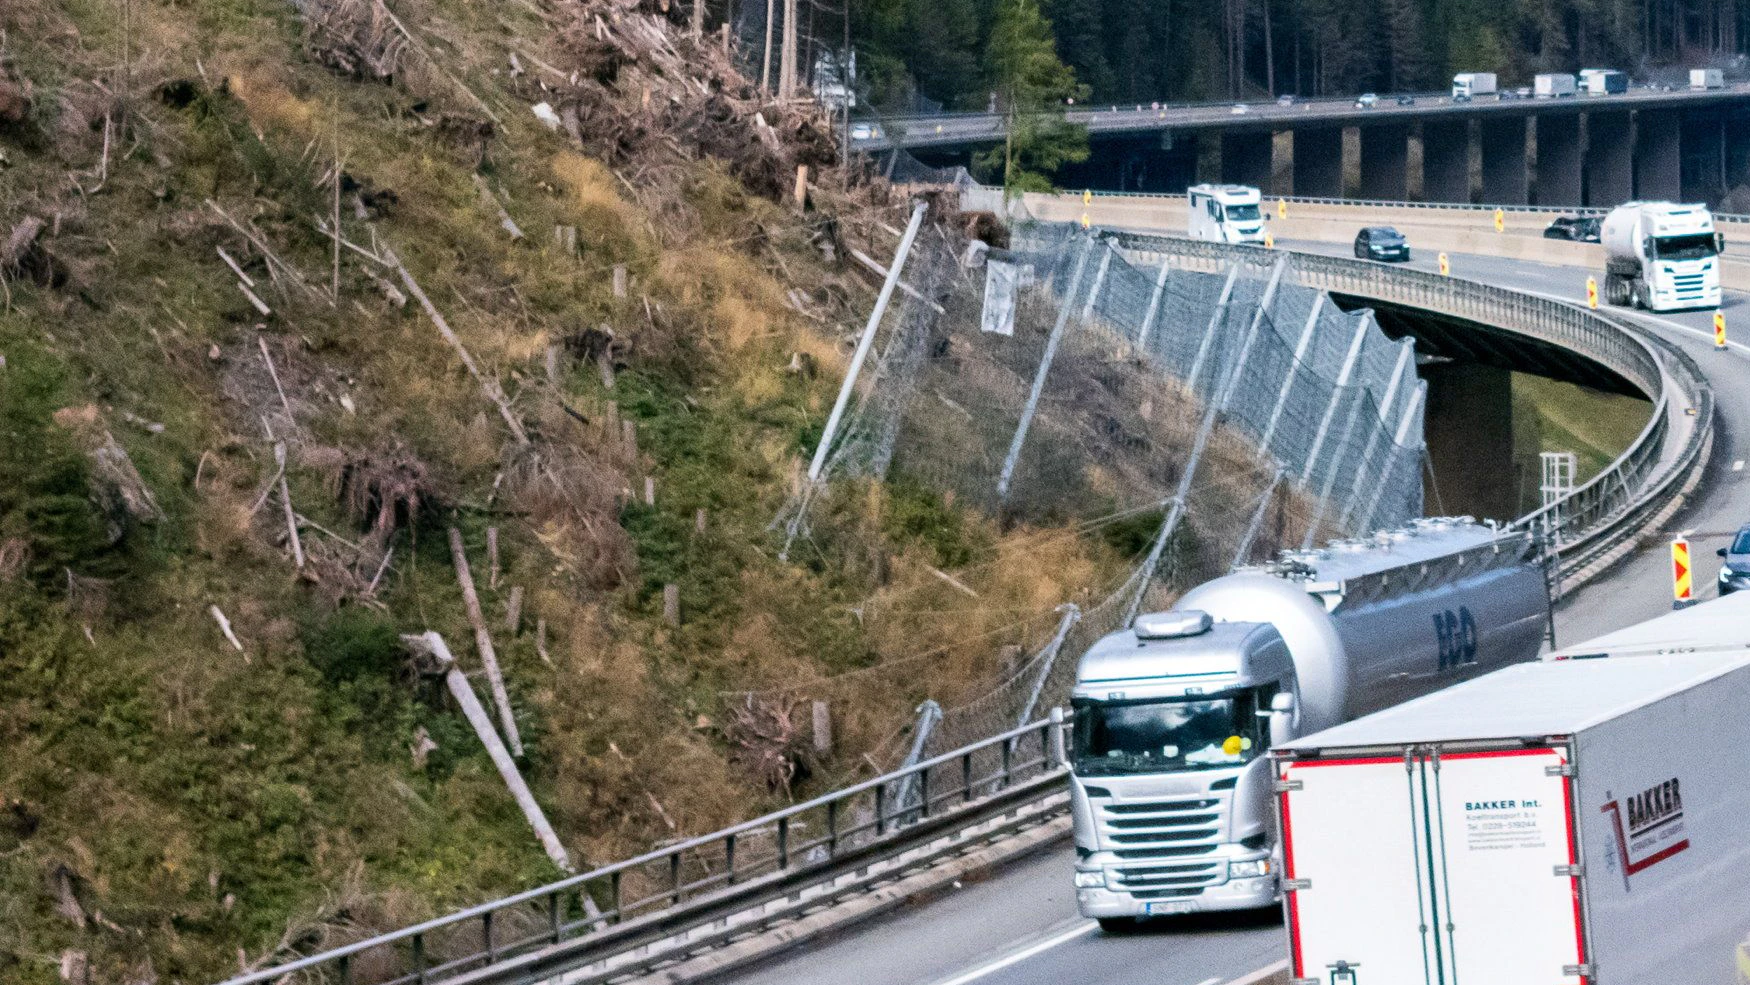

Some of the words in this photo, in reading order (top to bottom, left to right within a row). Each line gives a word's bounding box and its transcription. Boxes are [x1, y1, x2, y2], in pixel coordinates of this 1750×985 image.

[1465, 800, 1516, 810] BAKKER
[1522, 800, 1541, 808] Int.
[1627, 777, 1683, 831] BAKKER
